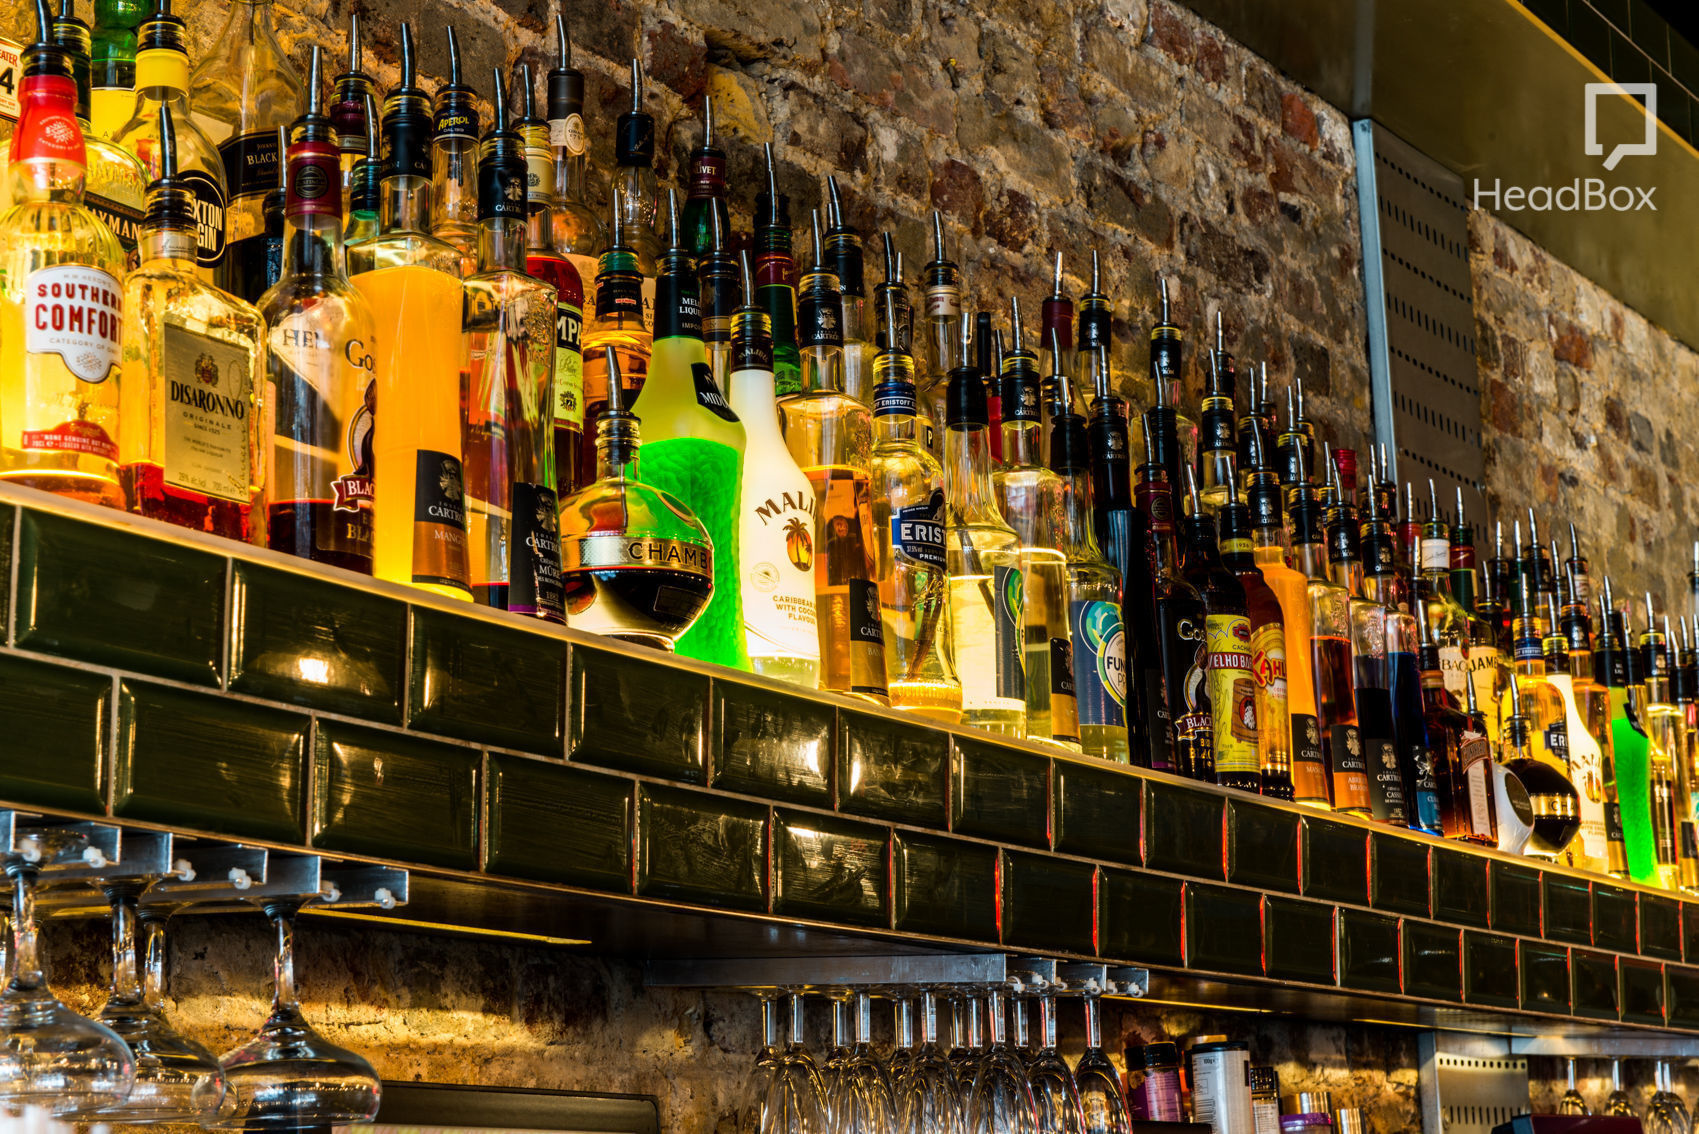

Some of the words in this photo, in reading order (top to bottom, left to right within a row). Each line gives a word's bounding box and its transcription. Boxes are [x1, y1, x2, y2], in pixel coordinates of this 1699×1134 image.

[438, 116, 470, 131] APEROL
[246, 152, 278, 166] BLACK
[197, 222, 217, 252] GIN
[738, 348, 769, 362] MALIBU
[170, 380, 245, 420] DISARONNO
[881, 398, 911, 407] ERISTOFF
[183, 411, 232, 431] ORIGINALE
[775, 604, 796, 613] WITH
